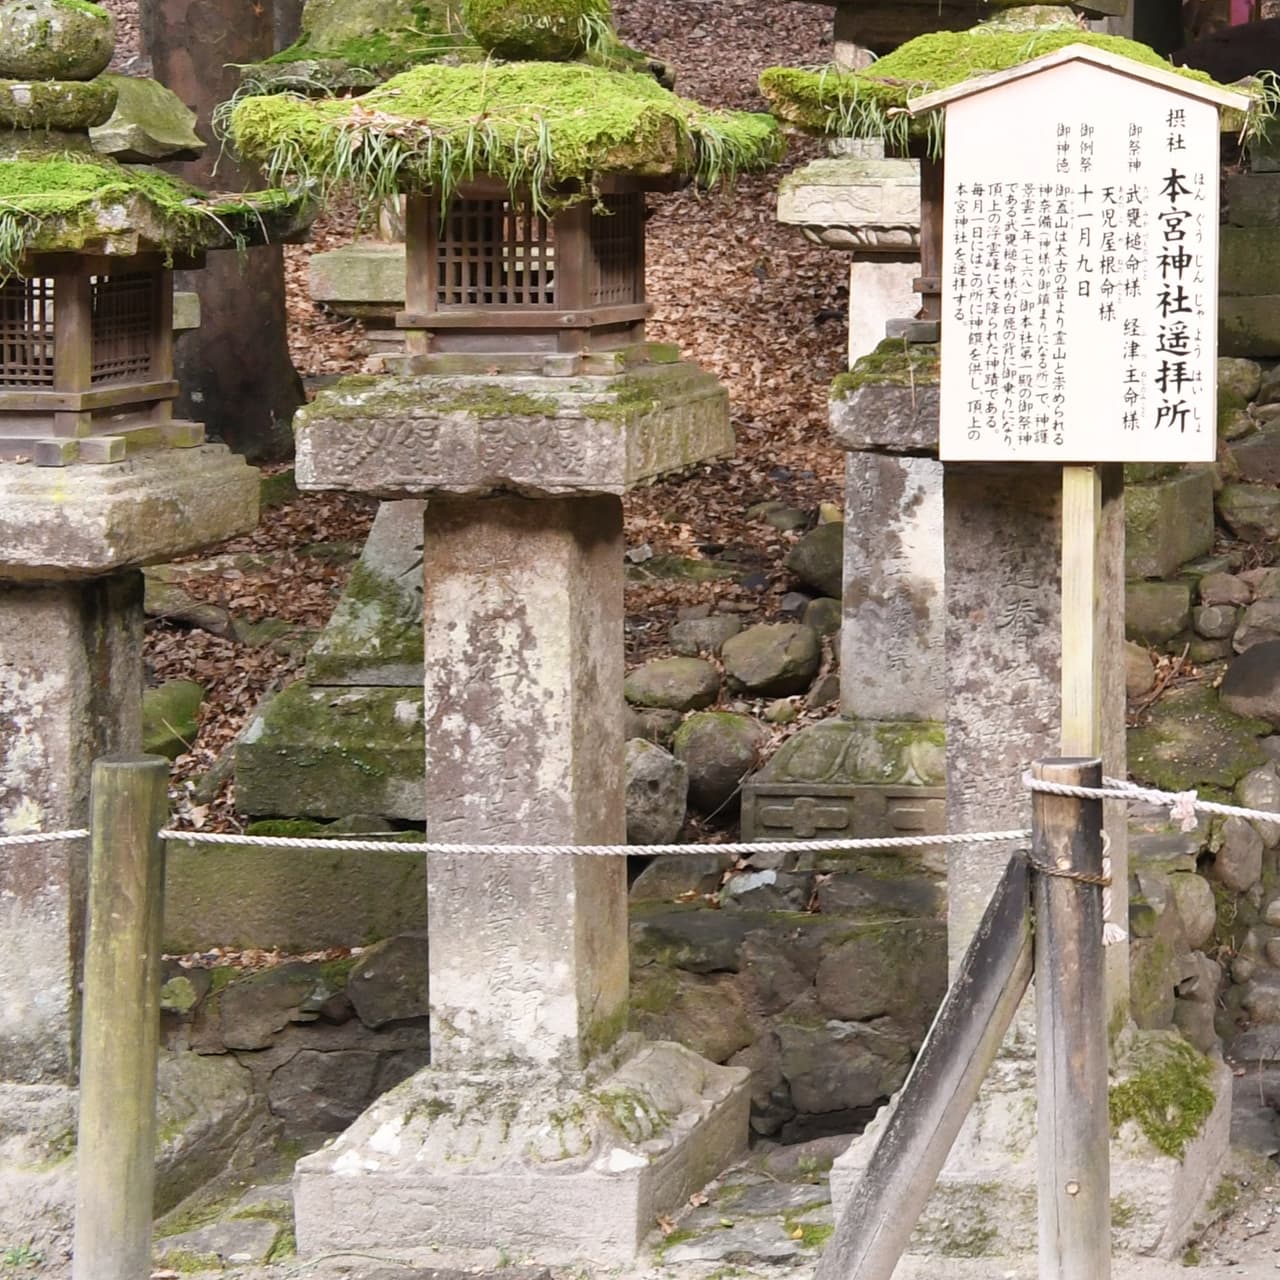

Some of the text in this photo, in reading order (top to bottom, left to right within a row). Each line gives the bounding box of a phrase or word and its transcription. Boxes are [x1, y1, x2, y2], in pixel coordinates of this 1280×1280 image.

[1056, 123, 1071, 173] 御神徳
[1128, 123, 1143, 173] 御祭神
[1076, 123, 1094, 298] 御例祭 十一月九日
[1099, 186, 1118, 322] 天児屋根命様
[1154, 108, 1194, 433] 摂社 本宮神社遥拝所
[1122, 318, 1141, 431] 経津主命様
